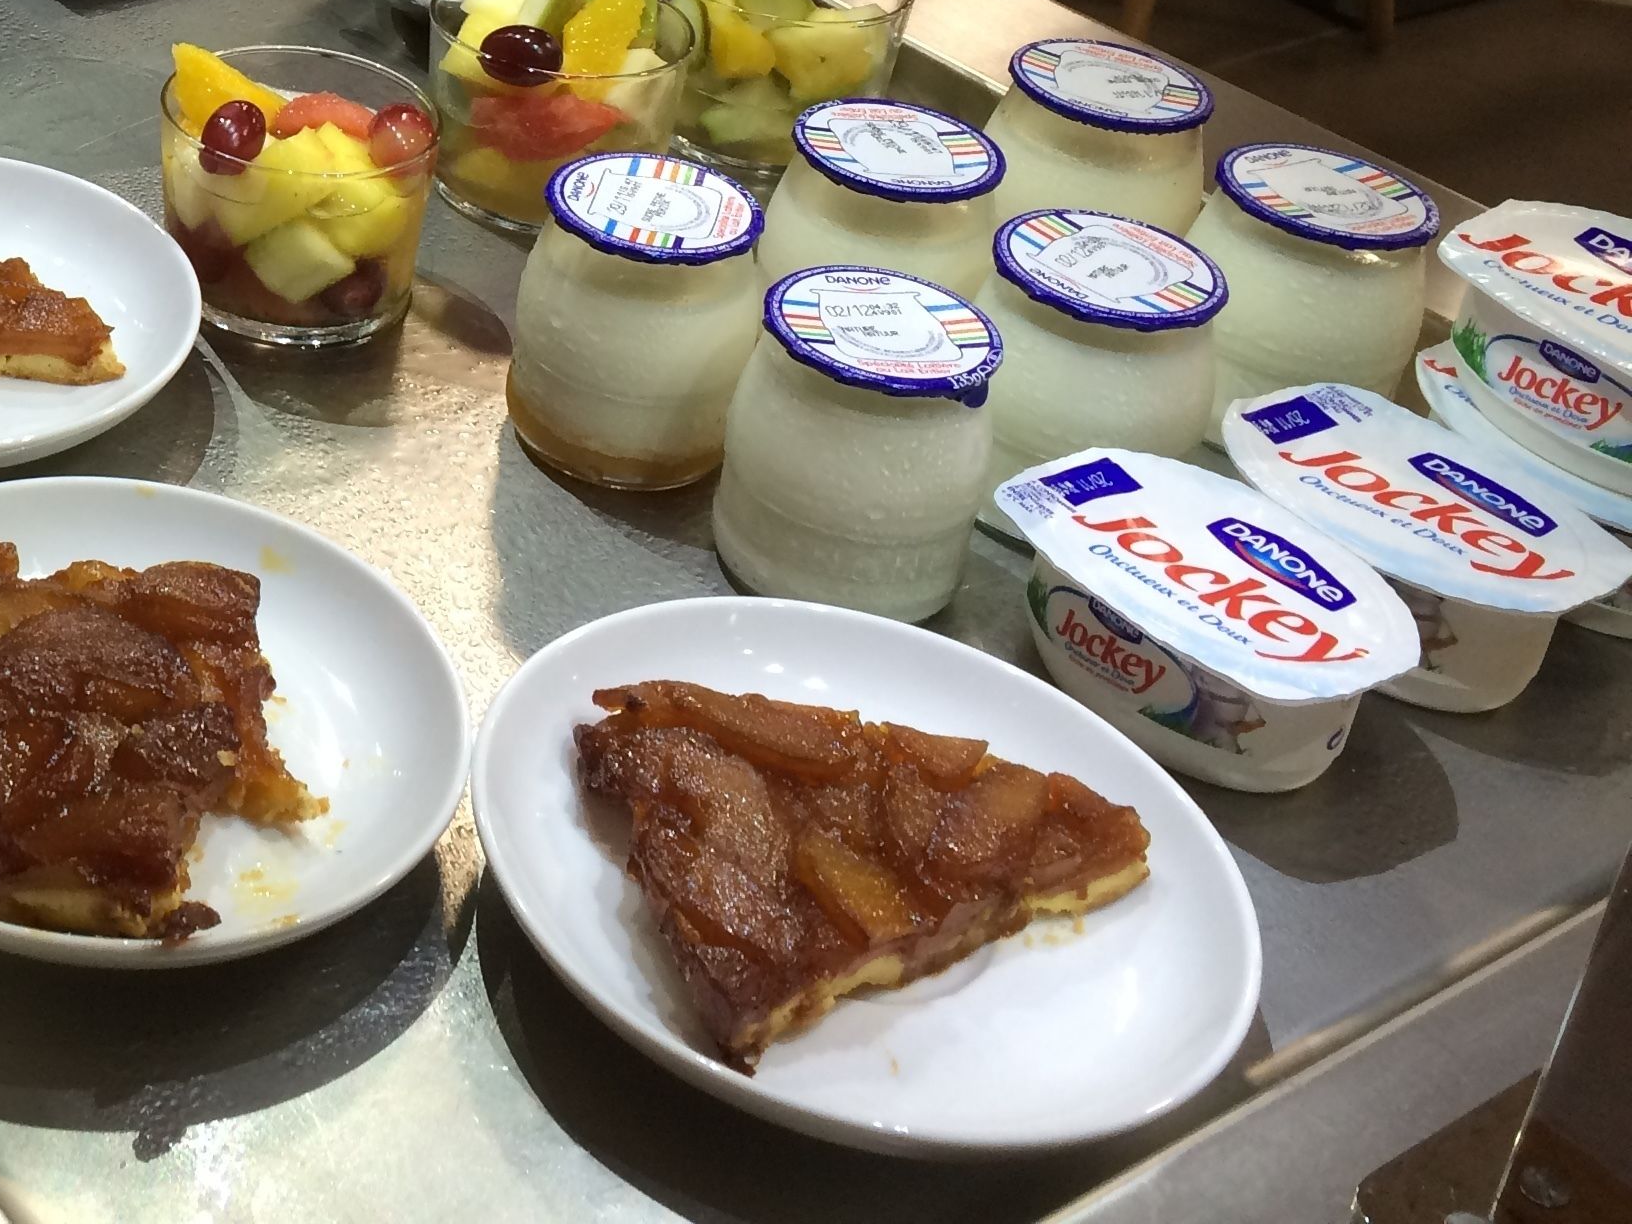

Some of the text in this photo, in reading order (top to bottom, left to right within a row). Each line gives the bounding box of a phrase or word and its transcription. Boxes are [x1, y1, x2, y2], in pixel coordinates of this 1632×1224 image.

[567, 171, 590, 203] DANONE
[824, 275, 891, 286] DANONE
[1029, 267, 1089, 300] DANONE
[1497, 355, 1624, 431] Jockey
[1544, 343, 1598, 377] DANONE
[1278, 451, 1576, 580] Jockey
[1299, 475, 1468, 556] Onctueux et Doux
[1421, 459, 1546, 530] DANONE
[1071, 514, 1370, 663] Jockey
[1088, 543, 1254, 646] Onctueux et Doux
[1222, 522, 1345, 604] DANONE
[1056, 609, 1167, 694] Jockey
